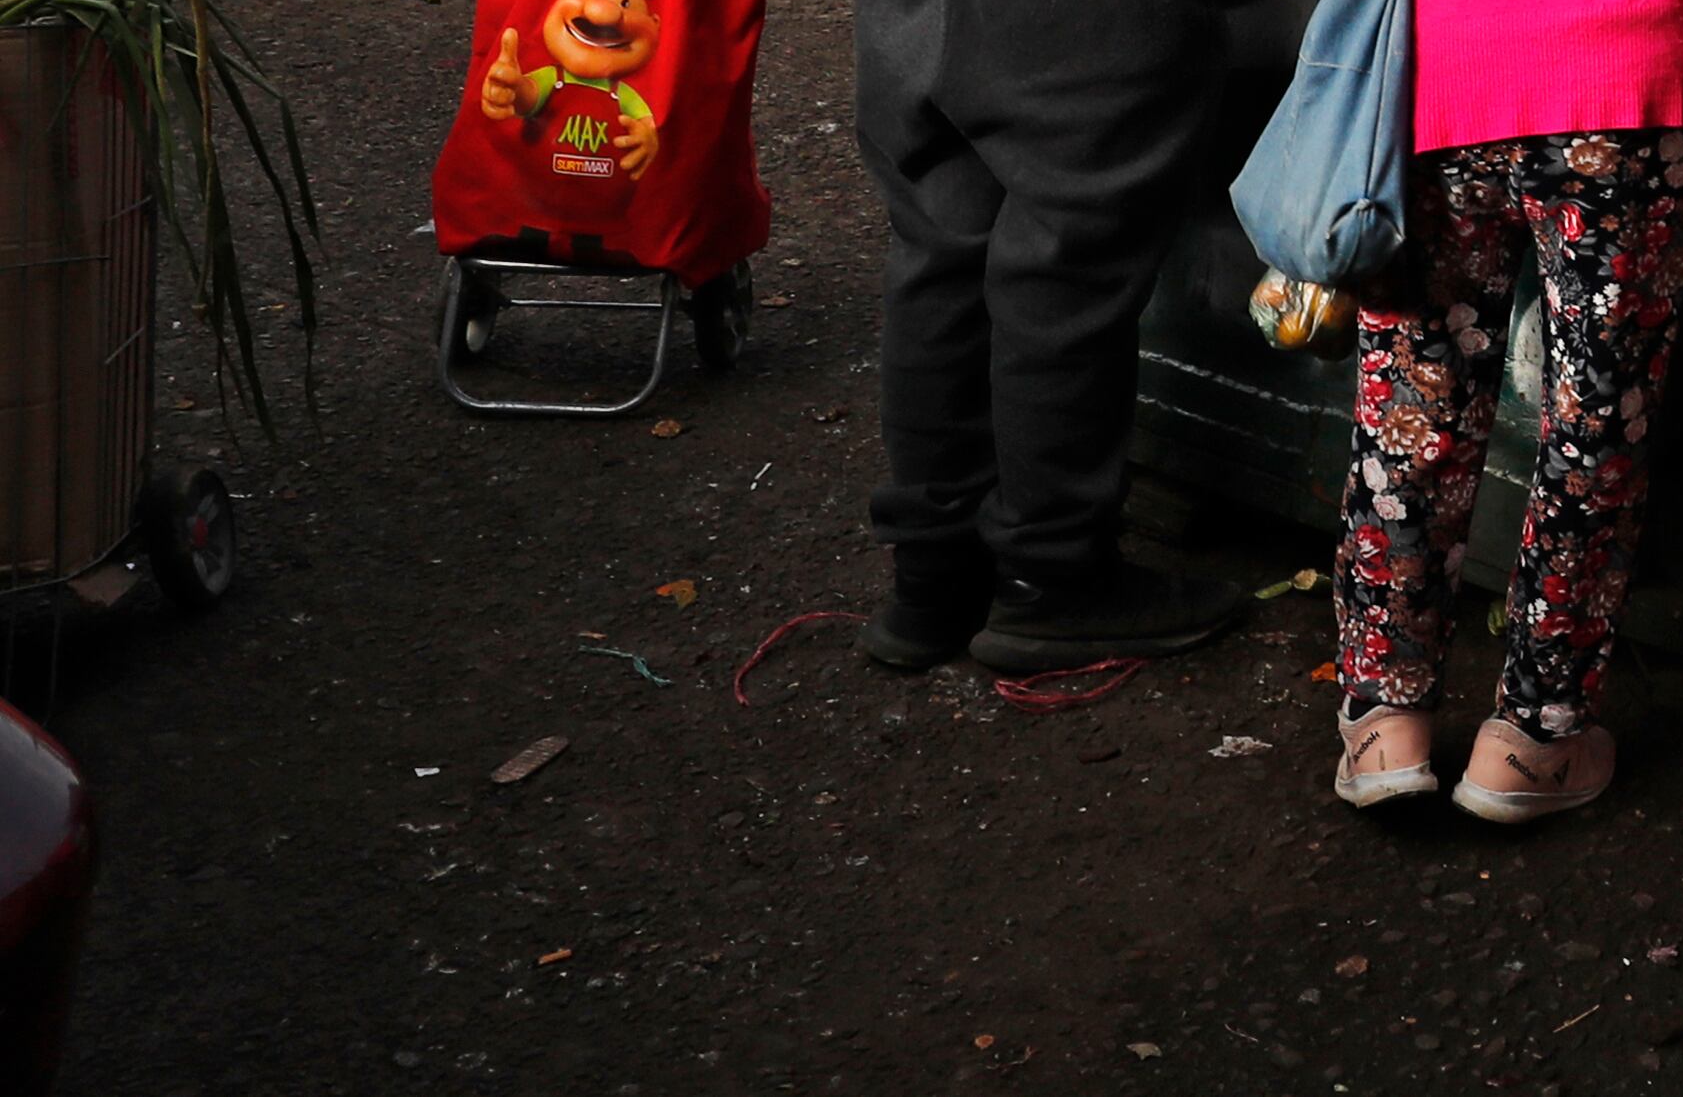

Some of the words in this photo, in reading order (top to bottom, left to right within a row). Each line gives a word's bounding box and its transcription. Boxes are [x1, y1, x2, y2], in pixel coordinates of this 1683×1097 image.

[558, 114, 608, 153] MAX
[556, 158, 610, 174] SURTIMAX
[1505, 752, 1538, 784] Reebok
